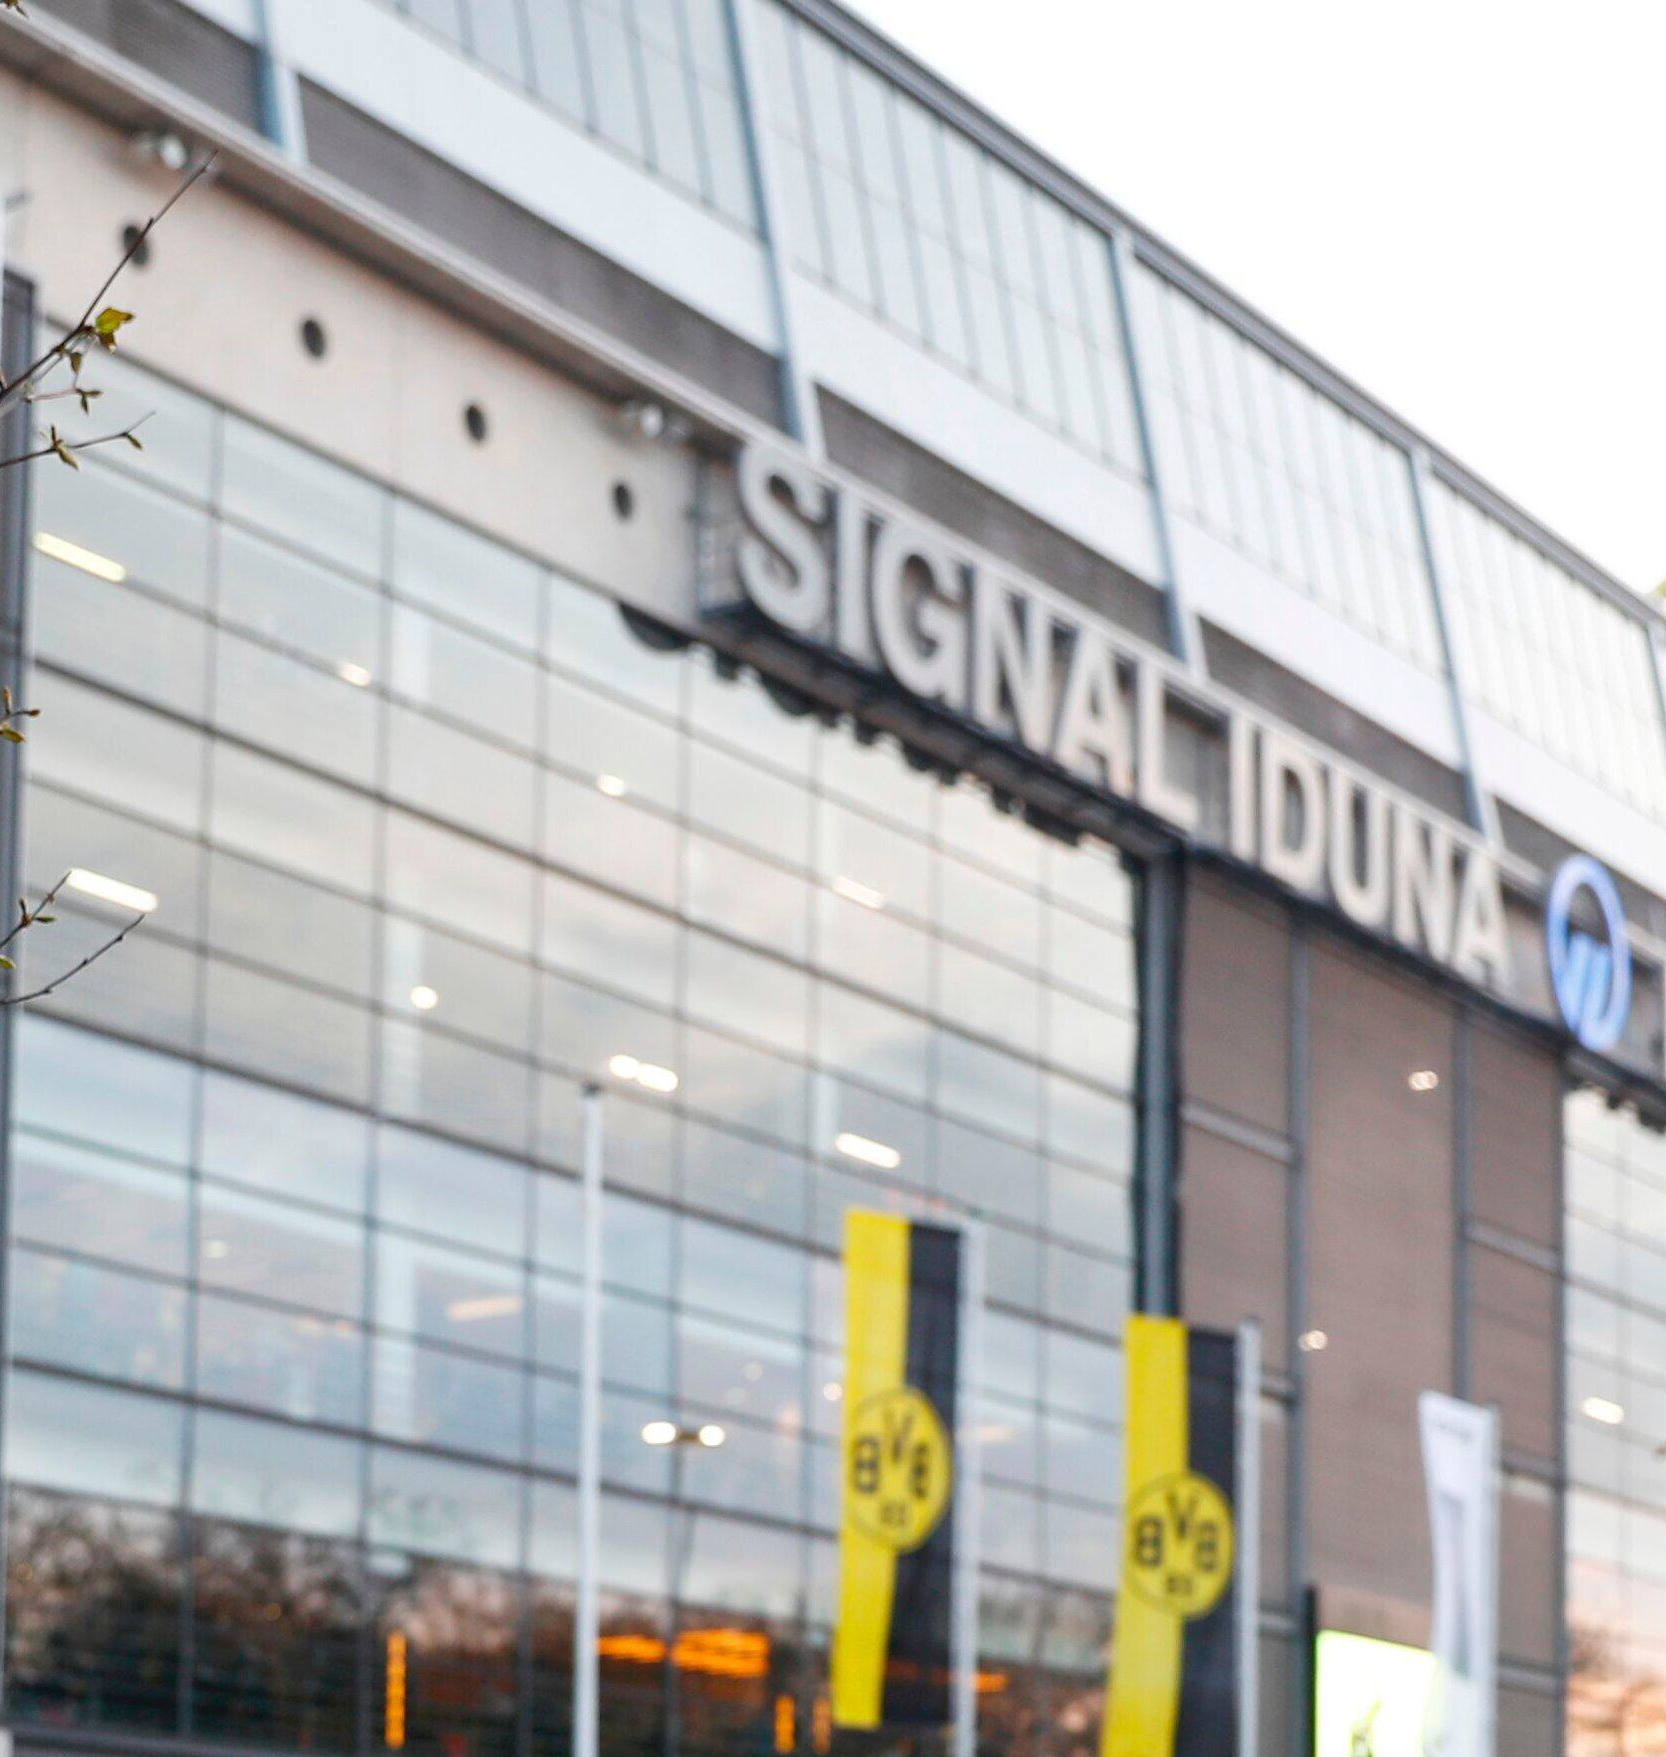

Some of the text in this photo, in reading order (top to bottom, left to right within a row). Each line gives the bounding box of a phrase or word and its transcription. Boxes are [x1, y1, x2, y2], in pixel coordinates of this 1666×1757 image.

[738, 443, 1200, 834] SIGNAL
[1230, 709, 1511, 990] IDUNA
[1134, 1488, 1221, 1573] BVB
